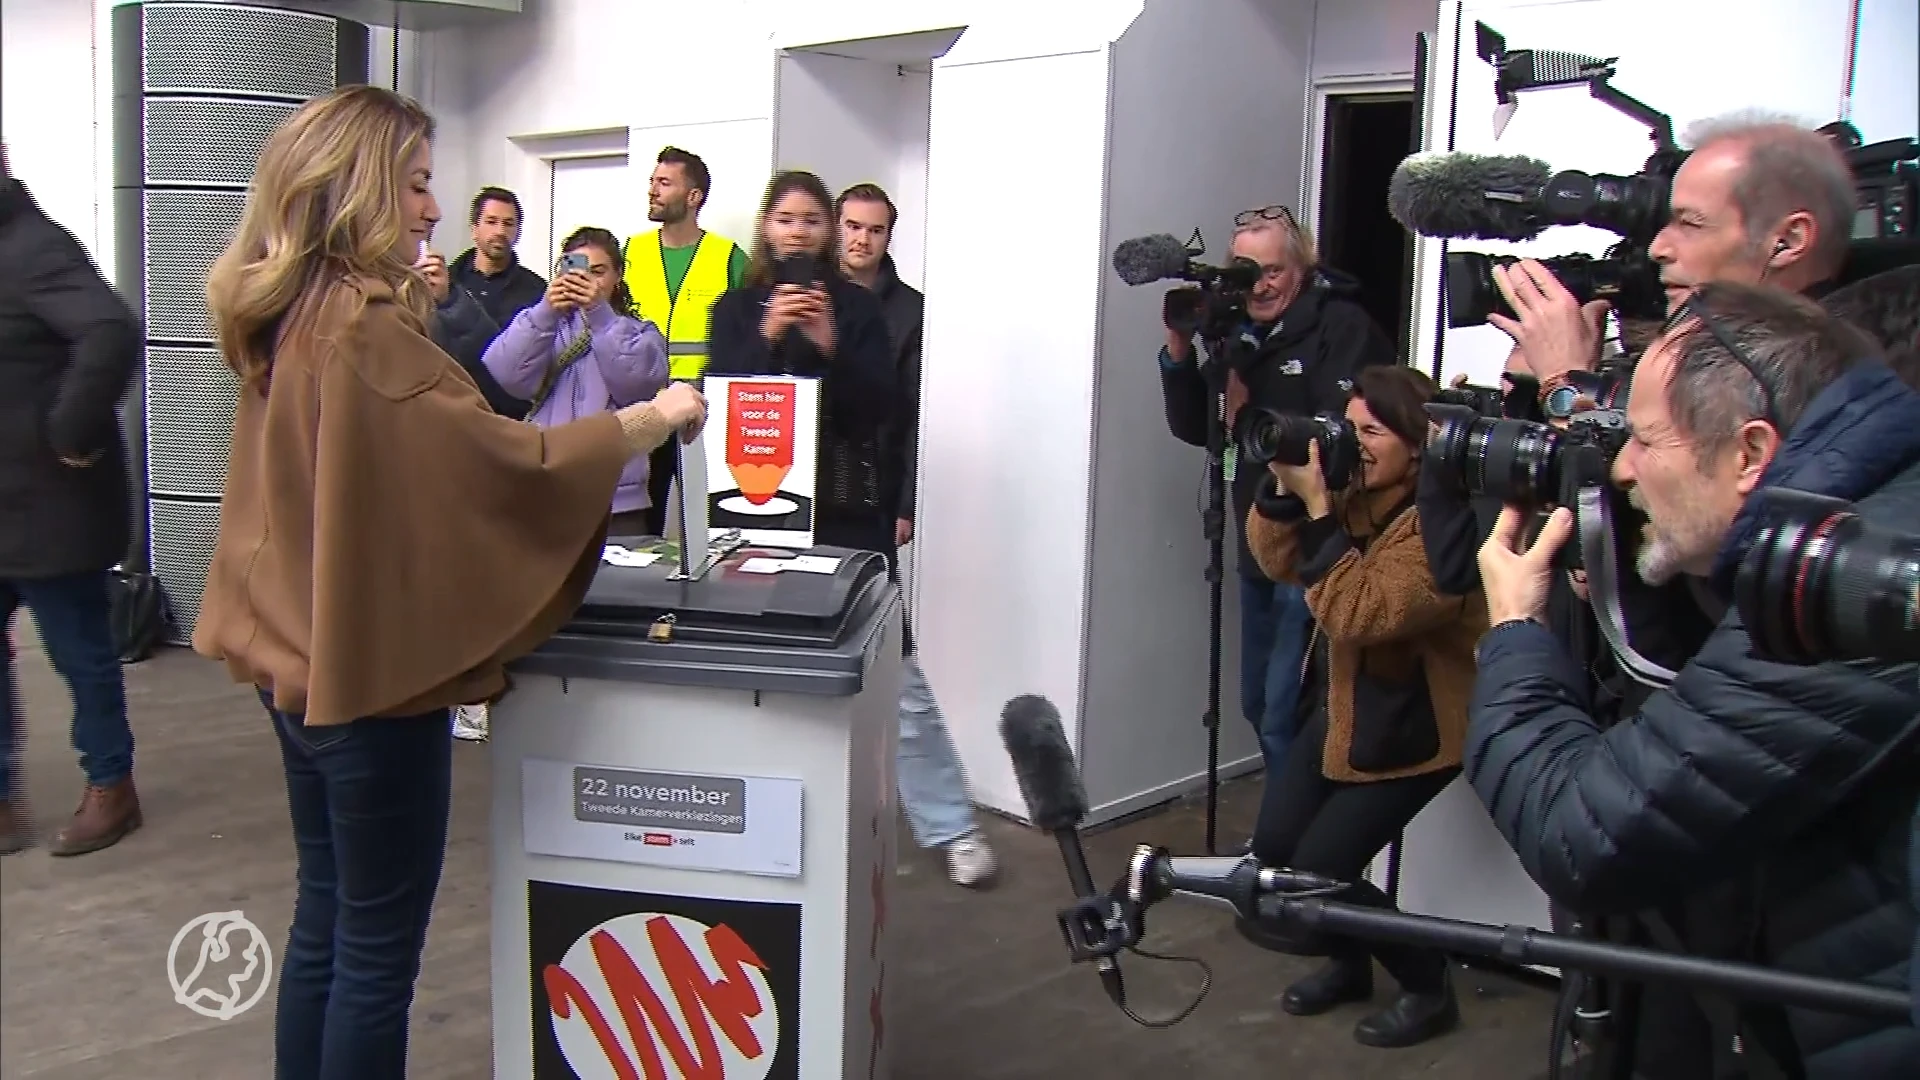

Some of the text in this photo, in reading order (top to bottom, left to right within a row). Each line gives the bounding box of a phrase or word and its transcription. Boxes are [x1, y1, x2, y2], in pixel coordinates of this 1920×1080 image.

[737, 391, 786, 403] Stem hier
[741, 409, 781, 420] voor de
[740, 426, 781, 438] Tweede
[743, 444, 777, 455] Kamer
[581, 778, 731, 806] 22 november
[581, 801, 743, 826] Tweede Kamerverkiezingen
[624, 832, 642, 842] Elke
